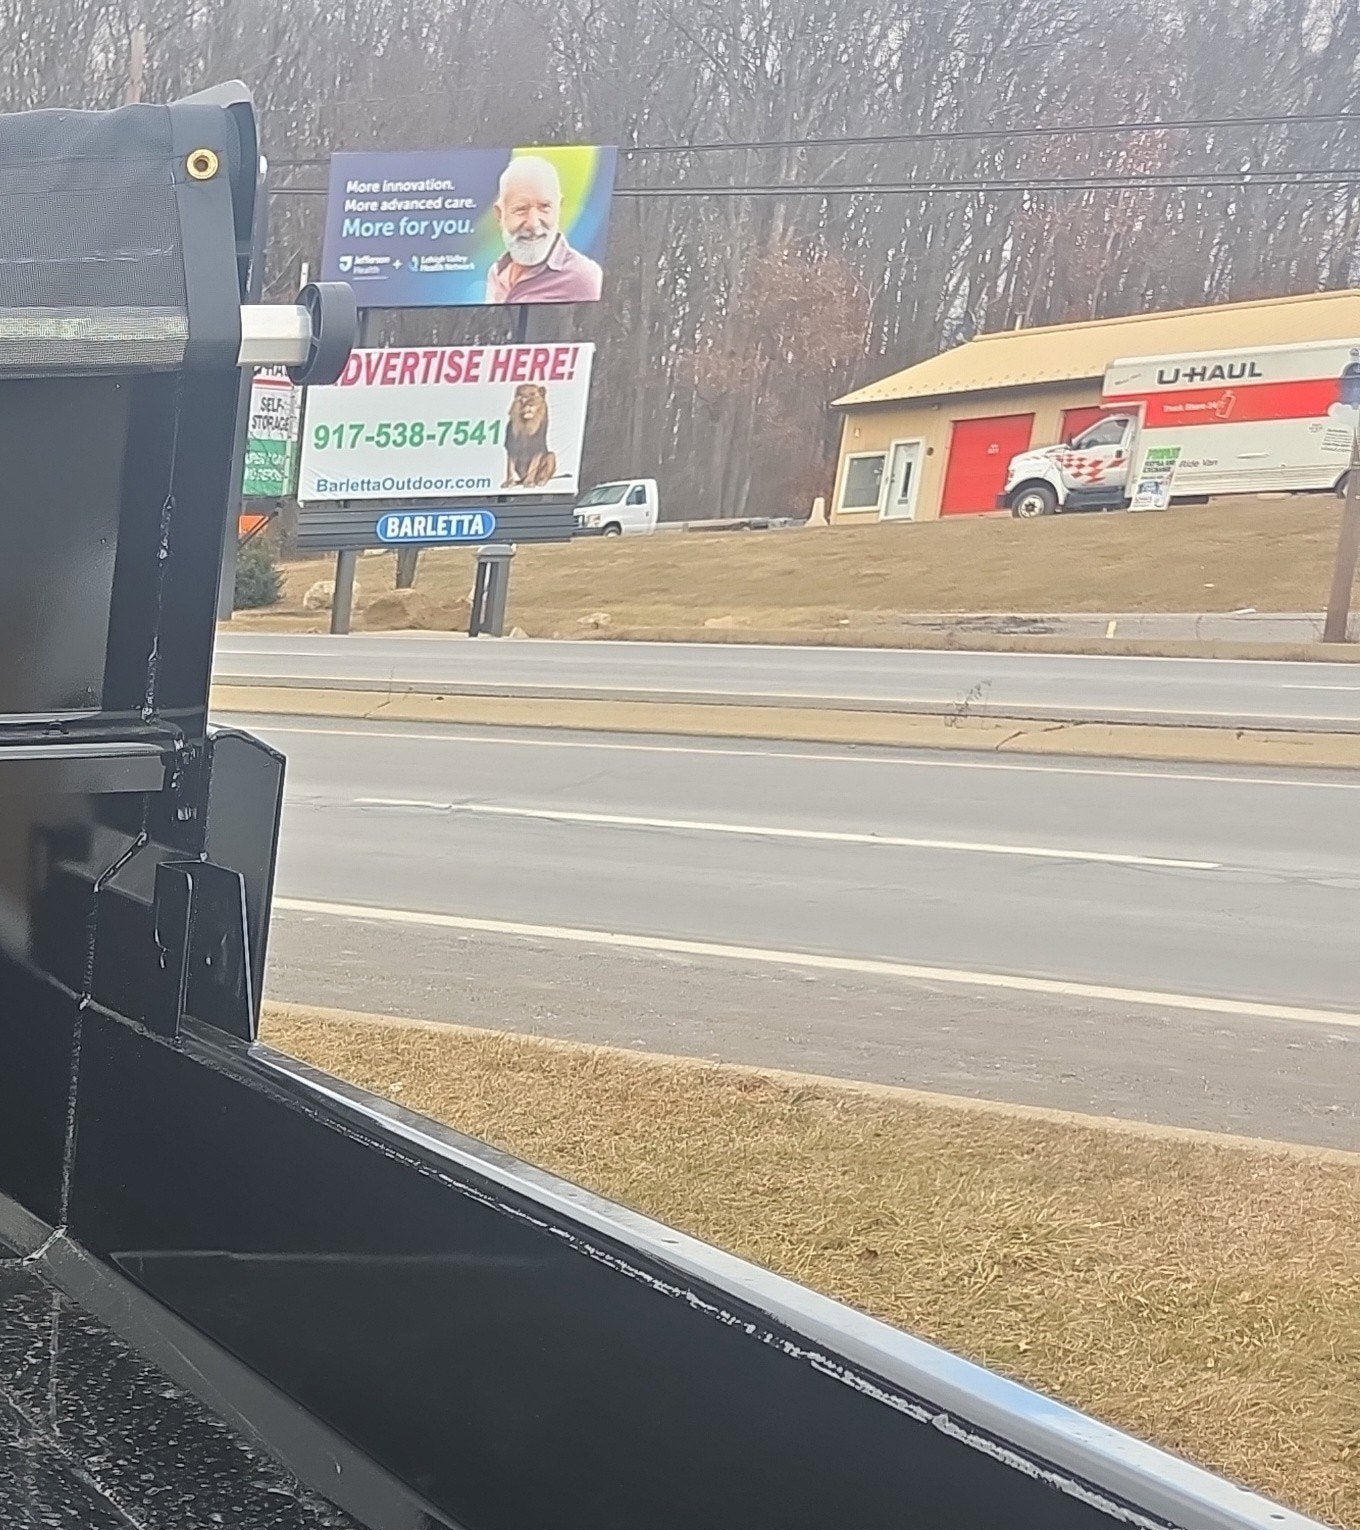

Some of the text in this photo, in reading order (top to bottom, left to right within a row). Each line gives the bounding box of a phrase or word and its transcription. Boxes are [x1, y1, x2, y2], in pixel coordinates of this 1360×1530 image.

[346, 178, 455, 193] More innovation.
[344, 197, 477, 212] More advanced care.
[342, 217, 474, 239] More for you.
[334, 348, 579, 387] DVERTISE HERE!
[1157, 362, 1262, 384] U-HAUL
[313, 419, 502, 450] 917-538-7541
[316, 476, 491, 493] BarlettaOutdoor.com
[386, 514, 484, 538] BARLETTA
